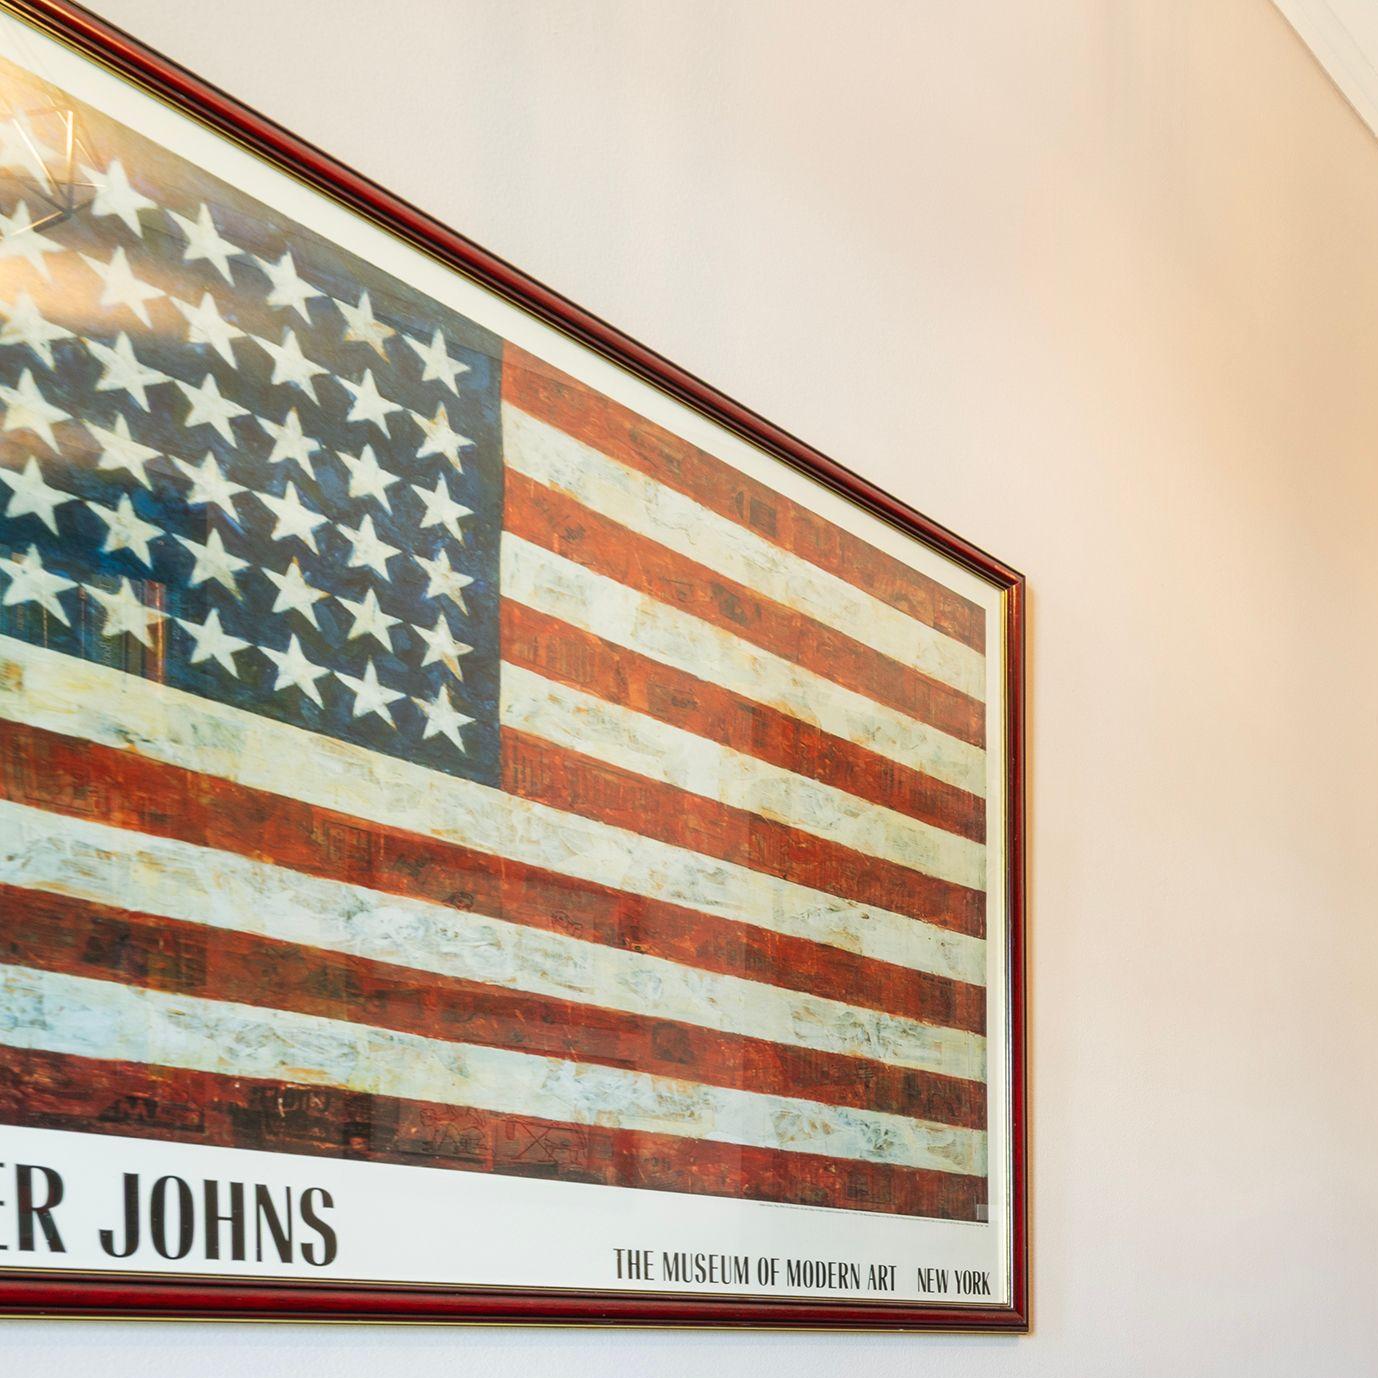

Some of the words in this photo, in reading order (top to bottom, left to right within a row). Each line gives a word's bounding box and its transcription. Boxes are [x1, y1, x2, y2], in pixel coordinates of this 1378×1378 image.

[0, 1163, 67, 1253] R
[98, 1172, 338, 1267] JOHNS
[612, 1248, 655, 1281] THE
[662, 1252, 750, 1286] MUSEUM
[757, 1257, 780, 1288] OF
[786, 1259, 861, 1291] MODERN
[867, 1264, 897, 1292] ART
[917, 1267, 958, 1294] NEW
[954, 1270, 992, 1296] YORK
